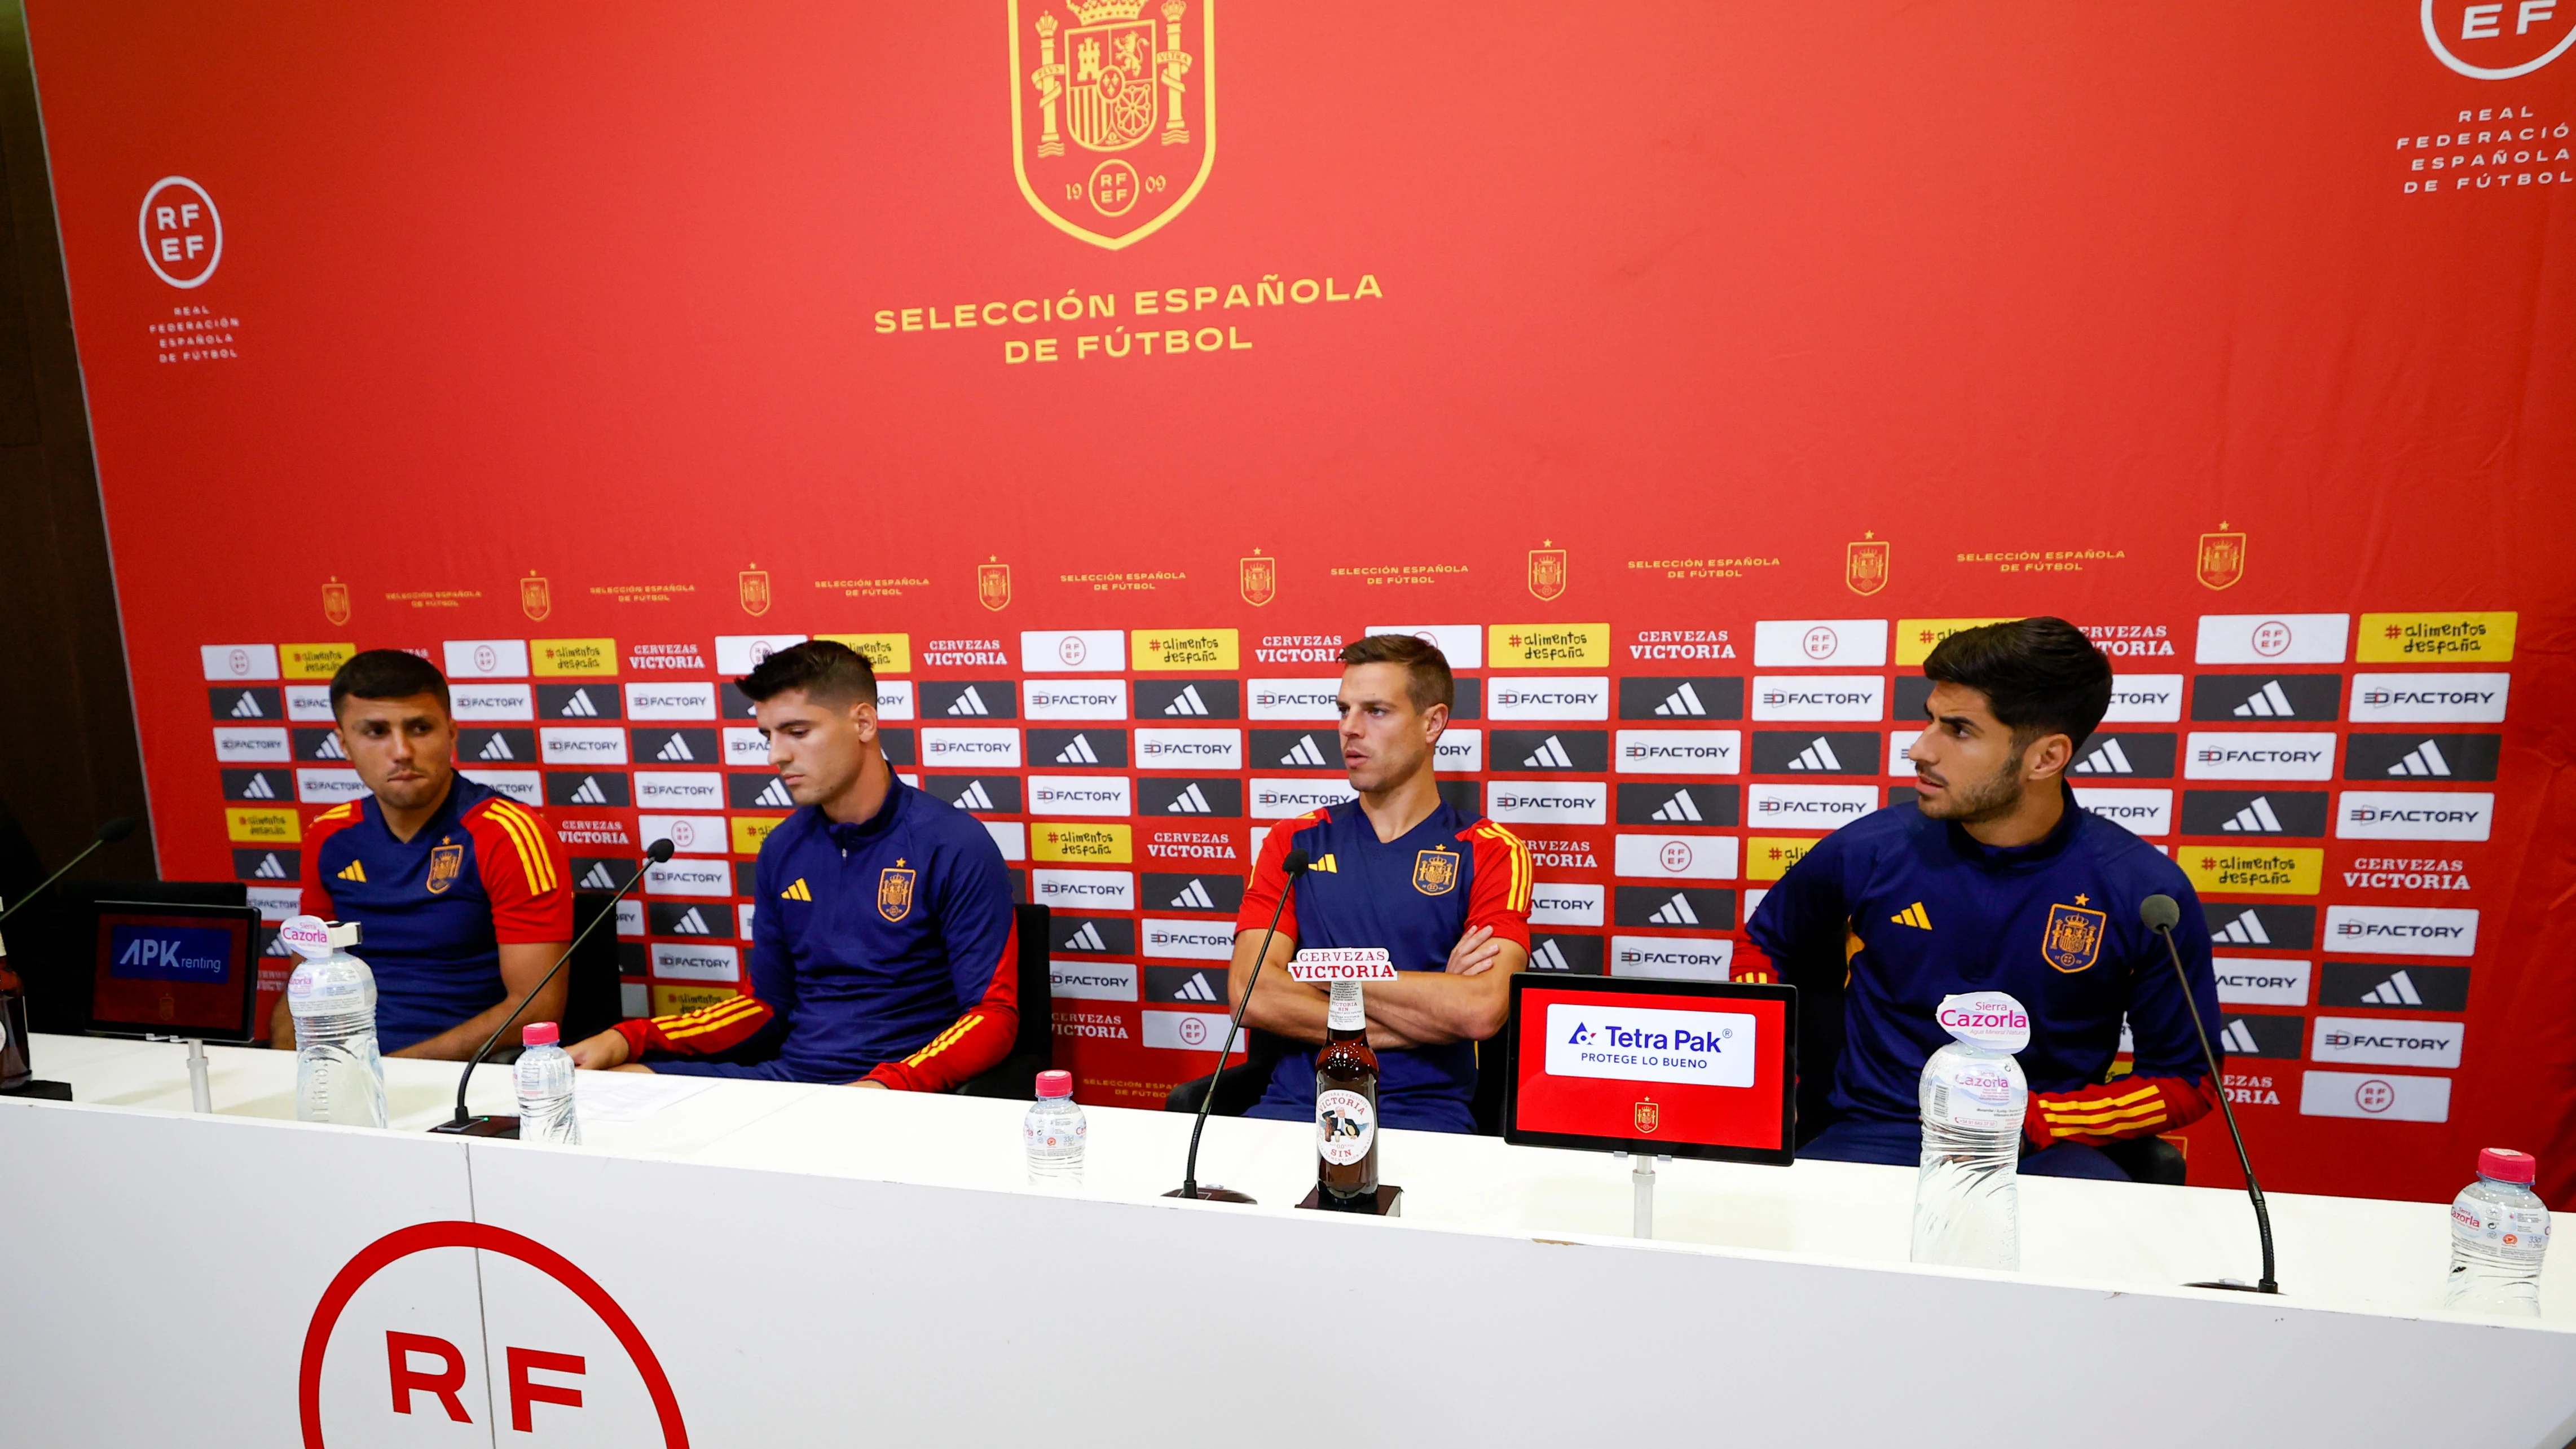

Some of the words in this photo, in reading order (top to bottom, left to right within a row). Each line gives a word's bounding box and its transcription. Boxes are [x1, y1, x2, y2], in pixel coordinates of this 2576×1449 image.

[2458, 105, 2534, 123] REAL
[2396, 121, 2576, 151] FEDERACIÓ
[2411, 148, 2570, 172] ESPAÑOLA
[1145, 174, 1166, 193] 09
[2403, 179, 2438, 193] DE
[2456, 171, 2573, 190] FÚTBOL
[1065, 183, 1083, 200] 19
[174, 305, 210, 316] REAL
[874, 288, 1117, 333] SELECCIÓN
[1135, 274, 1383, 315] ESPAÑOLA
[1005, 338, 1058, 364] DE
[1077, 325, 1253, 359] FÚTBOL
[159, 353, 177, 363] DE
[1957, 550, 2042, 562] SELECCIÓN
[2045, 549, 2125, 560] ESPAÑOLA
[1331, 565, 1401, 577] SELECCIÓN
[1403, 563, 1469, 574] ESPAÑOLA
[1628, 558, 1705, 570] SELECCIÓN
[1707, 557, 1780, 567] ESPAÑOLA
[2000, 563, 2020, 572] DE
[1060, 572, 1125, 583] SELECCIÓN
[1126, 571, 1186, 580] ESPAÑOLA
[1385, 573, 1435, 584] FÚTBOL
[1667, 570, 1685, 579] DE
[1688, 566, 1744, 578] FÚTBOL
[1093, 582, 1108, 591] DE
[1111, 580, 1156, 591] FÚTBOL
[1638, 630, 1728, 642] CERVEZAS
[2079, 625, 2168, 638] ERVEZAS
[2385, 621, 2487, 641] #alimentos
[847, 640, 891, 653] limentos
[929, 640, 1001, 651] CERVEZAS
[1149, 636, 1219, 652] #alimentos
[1261, 635, 1344, 647] CERVEZAS
[1508, 631, 1587, 648] #alimentos
[2403, 637, 2482, 653] despaña
[634, 644, 698, 655] CERVEZAS
[1524, 646, 1584, 661] despaña
[1629, 642, 1736, 659] VICTORIA
[2098, 640, 2175, 657] TORIA
[629, 654, 706, 669] VICTORIA
[923, 650, 1008, 666] VICTORIA
[1164, 649, 1218, 664] despaña
[1047, 831, 1113, 844] #alimentos
[1152, 832, 1229, 844] CERVEZAS
[1061, 842, 1113, 856] despaña
[1147, 844, 1236, 859] VICTORIA
[1527, 839, 1591, 852] RVEZAS
[1533, 852, 1599, 868] TORIA
[2201, 856, 2296, 871] #alimentos
[2353, 858, 2464, 873] CERVEZAS
[2343, 871, 2471, 890] VICTORIA
[283, 928, 328, 944] Cazorla
[118, 937, 180, 968] APK
[181, 955, 222, 974] renting
[1299, 950, 1386, 962] CERVEZAS
[1291, 964, 1395, 979] VICTORIA
[1975, 1001, 2007, 1011] Sierra
[1940, 1009, 2027, 1028] Cazorla
[1605, 1025, 1667, 1050] Tetra
[1581, 1052, 1637, 1064] PROTEGE
[1642, 1056, 1658, 1066] LO
[1663, 1058, 1707, 1069] BUENO
[2223, 1074, 2273, 1089] EZAS
[2225, 1087, 2281, 1106] ORIA
[1319, 1097, 1365, 1115] VICTORIA
[1331, 1148, 1351, 1157] SIN
